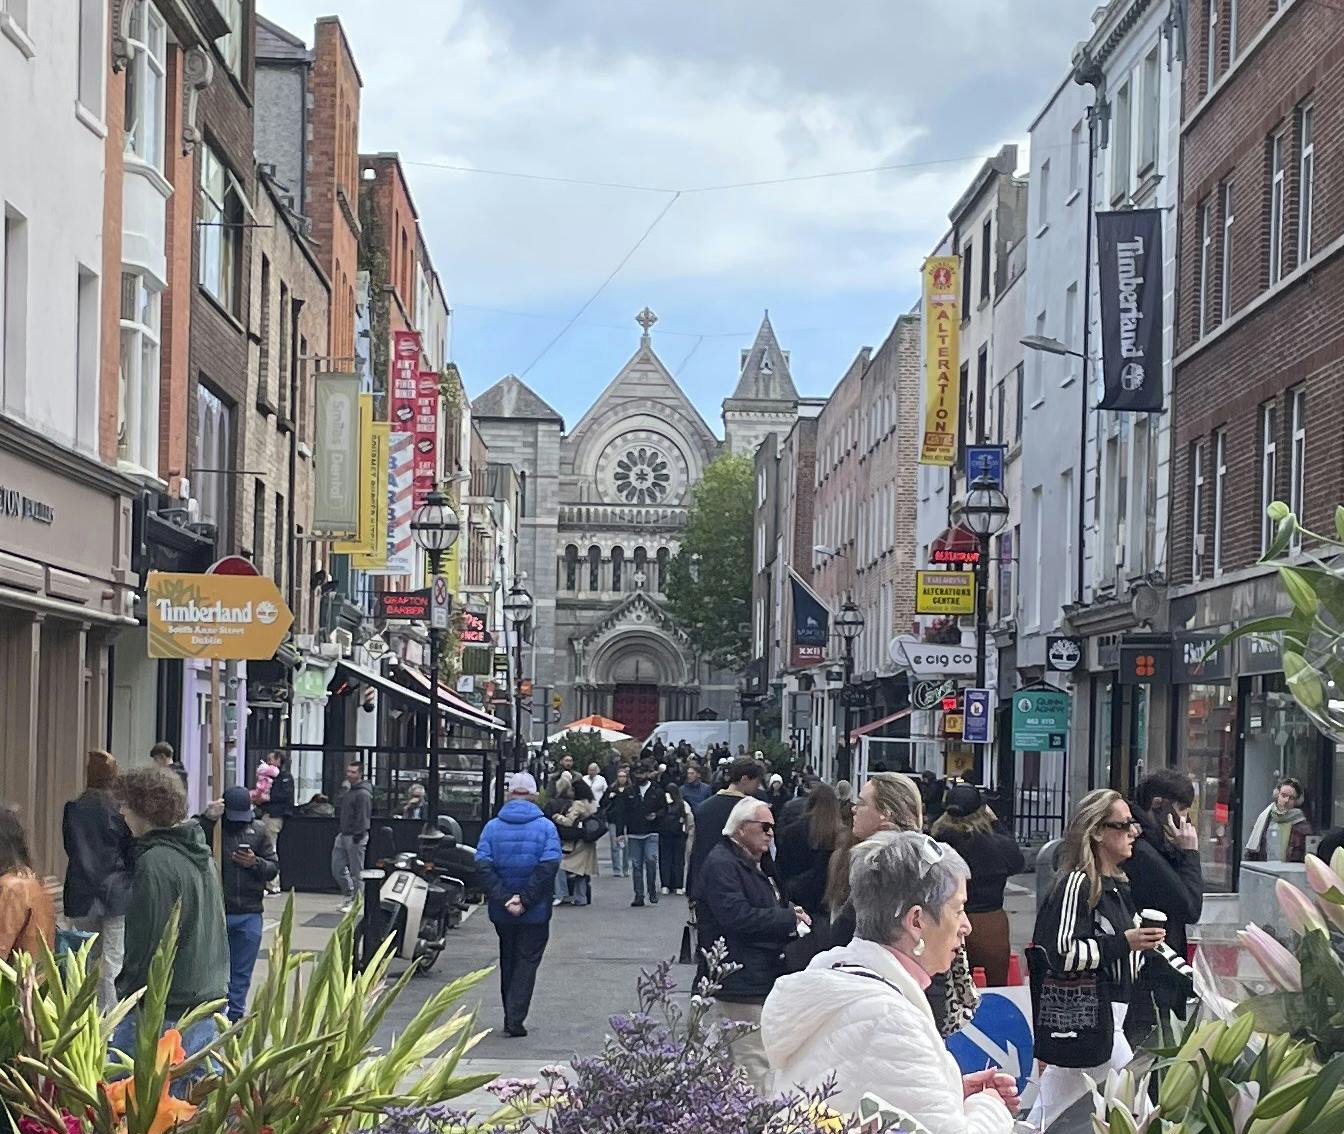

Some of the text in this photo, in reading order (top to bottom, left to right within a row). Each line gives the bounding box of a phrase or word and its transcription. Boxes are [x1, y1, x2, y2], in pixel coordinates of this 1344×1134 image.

[1117, 236, 1144, 358] Timberland
[936, 309, 950, 432] ALTERATION
[922, 587, 971, 597] ALTERATIONS
[156, 599, 252, 622] Timberland
[926, 654, 949, 668] cig
[953, 654, 973, 664] co
